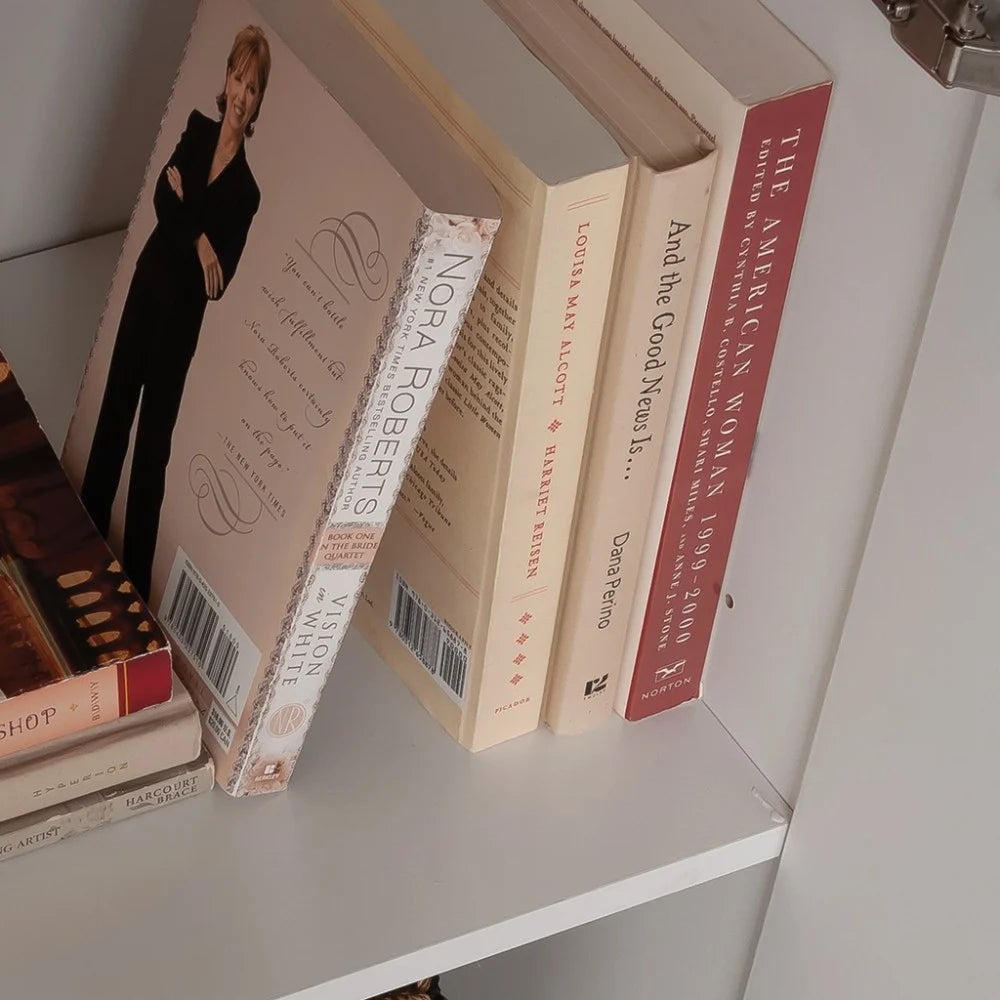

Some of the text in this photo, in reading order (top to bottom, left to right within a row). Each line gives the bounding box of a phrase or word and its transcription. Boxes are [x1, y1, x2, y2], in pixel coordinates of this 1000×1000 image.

[750, 139, 771, 202] EDITED
[770, 128, 801, 197] THE
[663, 220, 691, 267] And
[745, 210, 756, 228] BY
[410, 253, 474, 351] NORA
[656, 272, 680, 306] the
[727, 237, 750, 311] CYNTHIA
[732, 218, 781, 376] AMERICAN
[261, 286, 286, 313] wish
[327, 360, 345, 381] but
[323, 300, 347, 329] bottle
[552, 222, 590, 405] LOUISA MAY ALCOTT
[644, 312, 675, 371] Good
[238, 359, 262, 391] knows
[263, 388, 278, 411] how
[244, 319, 333, 428] Nora Roberts certainly
[341, 258, 434, 511] #1 NEW YORK TIMES BESTSELLING AUTHOR
[633, 375, 663, 432] News
[241, 418, 250, 429] on
[252, 429, 273, 454] the
[354, 366, 432, 515] ROBERTS
[694, 429, 711, 473] SHARI
[706, 392, 744, 497] WOMAN
[236, 452, 249, 472] NEW
[251, 470, 266, 491] YORK
[268, 492, 286, 518] TIMES
[527, 445, 556, 579] HARRIET REISEN
[324, 552, 364, 560] QUARTET
[598, 531, 630, 629] Dana Perino
[670, 555, 684, 589] ANNE
[281, 587, 326, 686] in WHITE
[305, 595, 348, 676] VISION
[658, 608, 673, 651] STONE
[641, 677, 691, 700] NORTON
[33, 762, 128, 798] HYPERION
[126, 776, 198, 807] HARCOURT
[157, 783, 197, 804] BRACE
[17, 827, 60, 848] ARTIST
